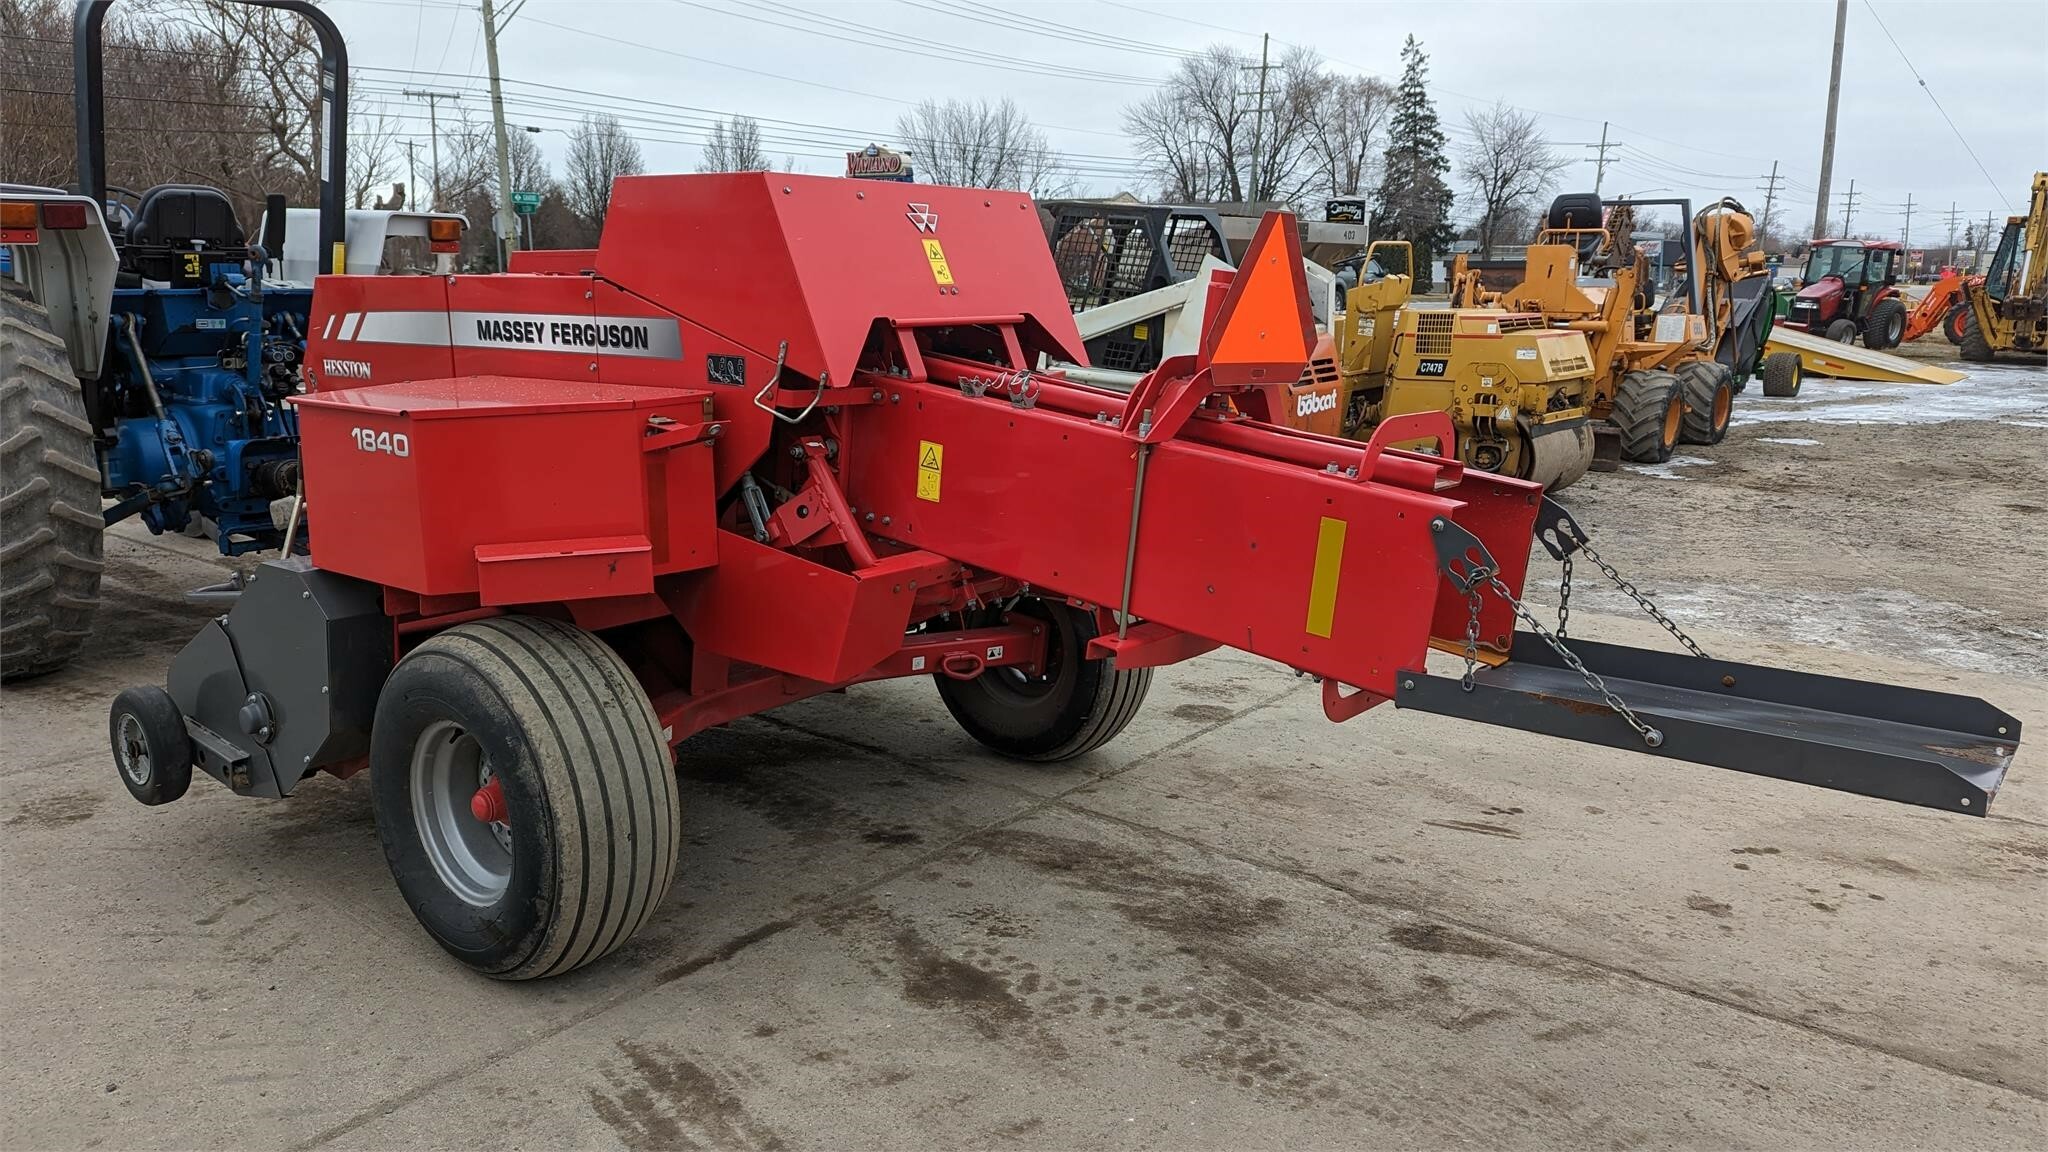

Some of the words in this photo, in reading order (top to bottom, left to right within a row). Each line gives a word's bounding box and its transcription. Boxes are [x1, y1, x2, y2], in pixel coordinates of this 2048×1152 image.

[476, 319, 545, 344] MASSEY
[550, 322, 649, 350] FERGUSON
[323, 359, 370, 379] HESSTON
[1420, 362, 1444, 373] C747B
[1297, 389, 1337, 417] bobcat
[351, 427, 409, 457] 1840
